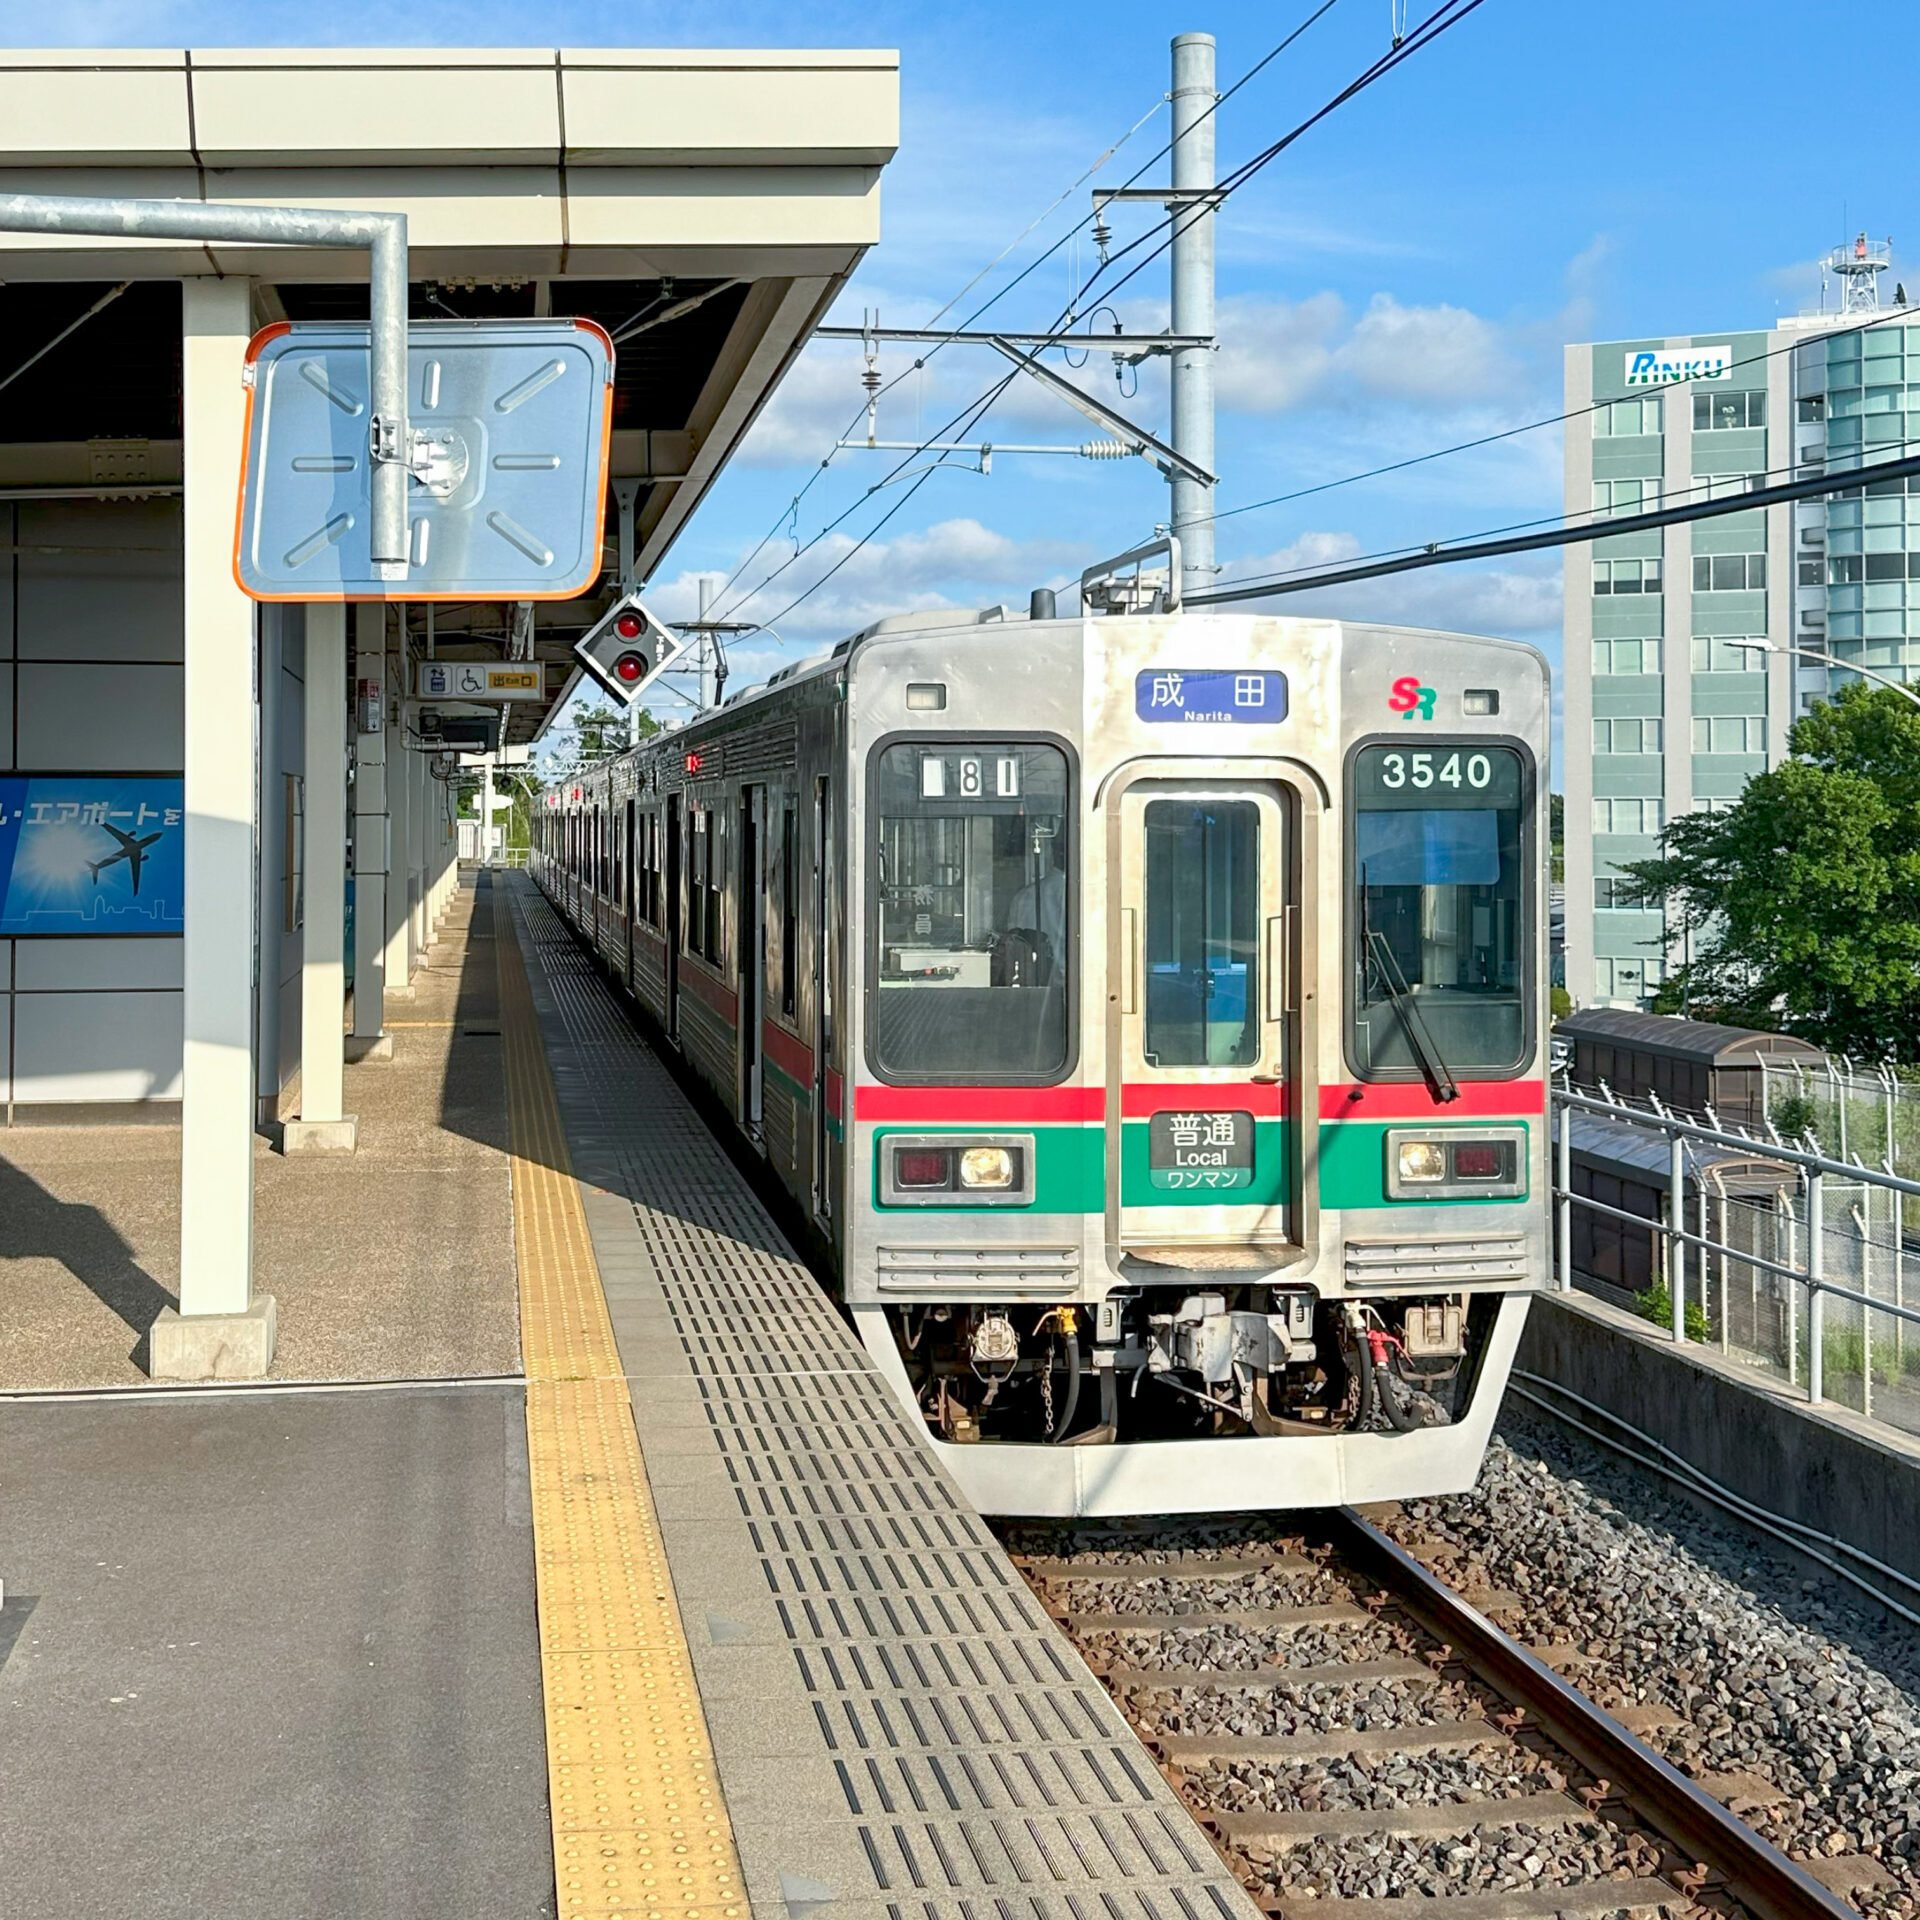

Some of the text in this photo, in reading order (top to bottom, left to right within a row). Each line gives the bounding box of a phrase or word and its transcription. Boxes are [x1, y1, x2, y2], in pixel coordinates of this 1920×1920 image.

[1151, 672, 1265, 707] 成田
[1388, 677, 1437, 720] SR
[1184, 711, 1232, 721] Narita
[1383, 753, 1491, 788] 3540
[1169, 1114, 1235, 1146] 普通
[1176, 1149, 1227, 1166] Local
[1168, 1172, 1238, 1189] ワンマン
